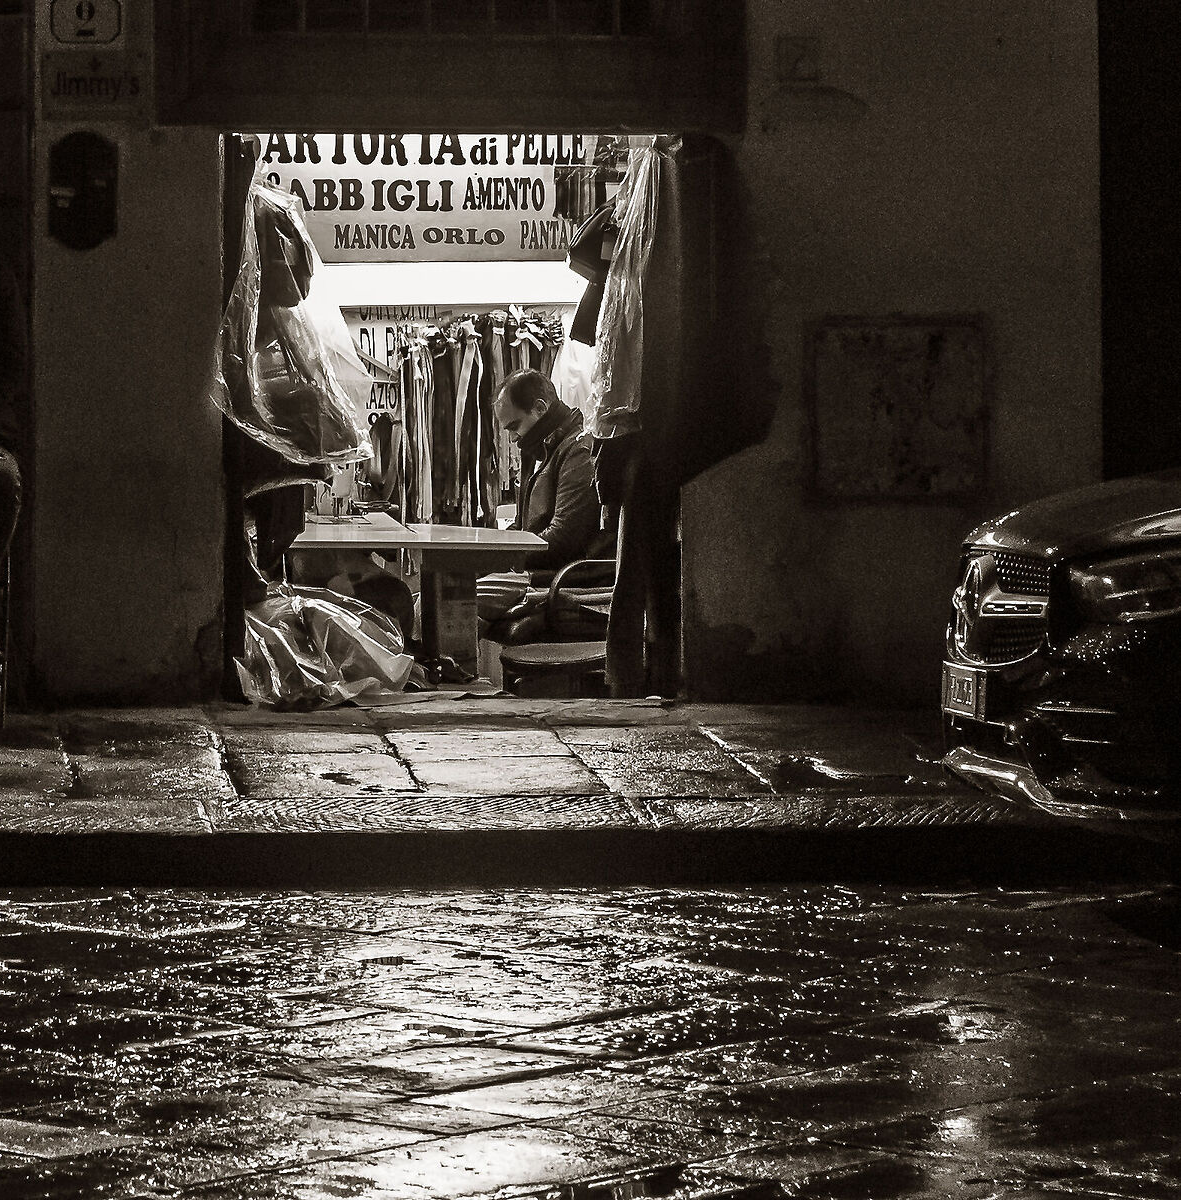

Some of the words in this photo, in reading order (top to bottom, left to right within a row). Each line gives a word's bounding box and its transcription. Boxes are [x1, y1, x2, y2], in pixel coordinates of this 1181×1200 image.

[50, 71, 140, 101] Jimmy's
[261, 133, 467, 166] ARTORIA
[469, 137, 499, 166] di
[505, 133, 587, 166] PELLE
[333, 224, 417, 250] MANICA
[422, 227, 506, 245] ORLO
[520, 220, 574, 250] PANTA
